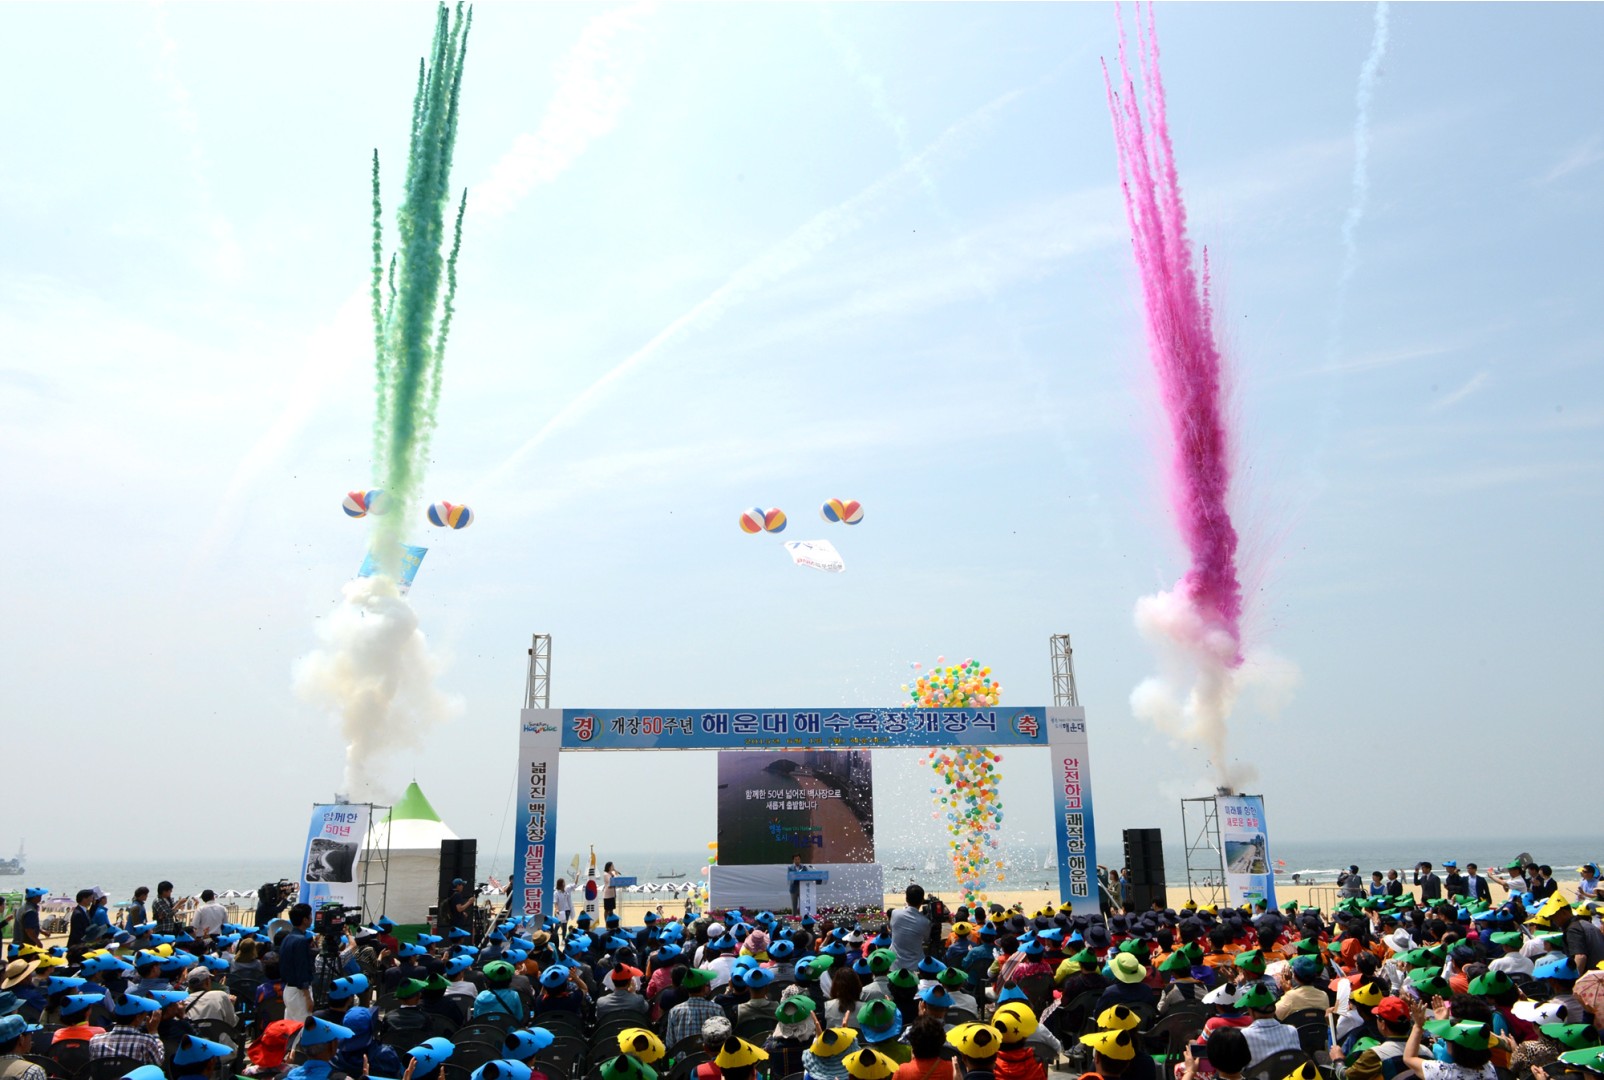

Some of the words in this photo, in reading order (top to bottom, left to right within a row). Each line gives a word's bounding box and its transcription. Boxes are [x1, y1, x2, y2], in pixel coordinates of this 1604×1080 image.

[572, 715, 595, 741] 경
[610, 715, 694, 736] 개장50주년
[1017, 714, 1039, 738] 축
[530, 762, 547, 799] 넓어진
[768, 789, 784, 799] 50년
[807, 789, 842, 799] 백사장으로
[1063, 758, 1082, 809] 안전하고
[325, 824, 351, 837] 50년
[528, 803, 547, 842] 백사장
[1066, 813, 1086, 854] 쾌적한
[524, 845, 544, 884] 새로운
[1068, 856, 1088, 897] 해운대
[523, 887, 543, 915] 탄생
